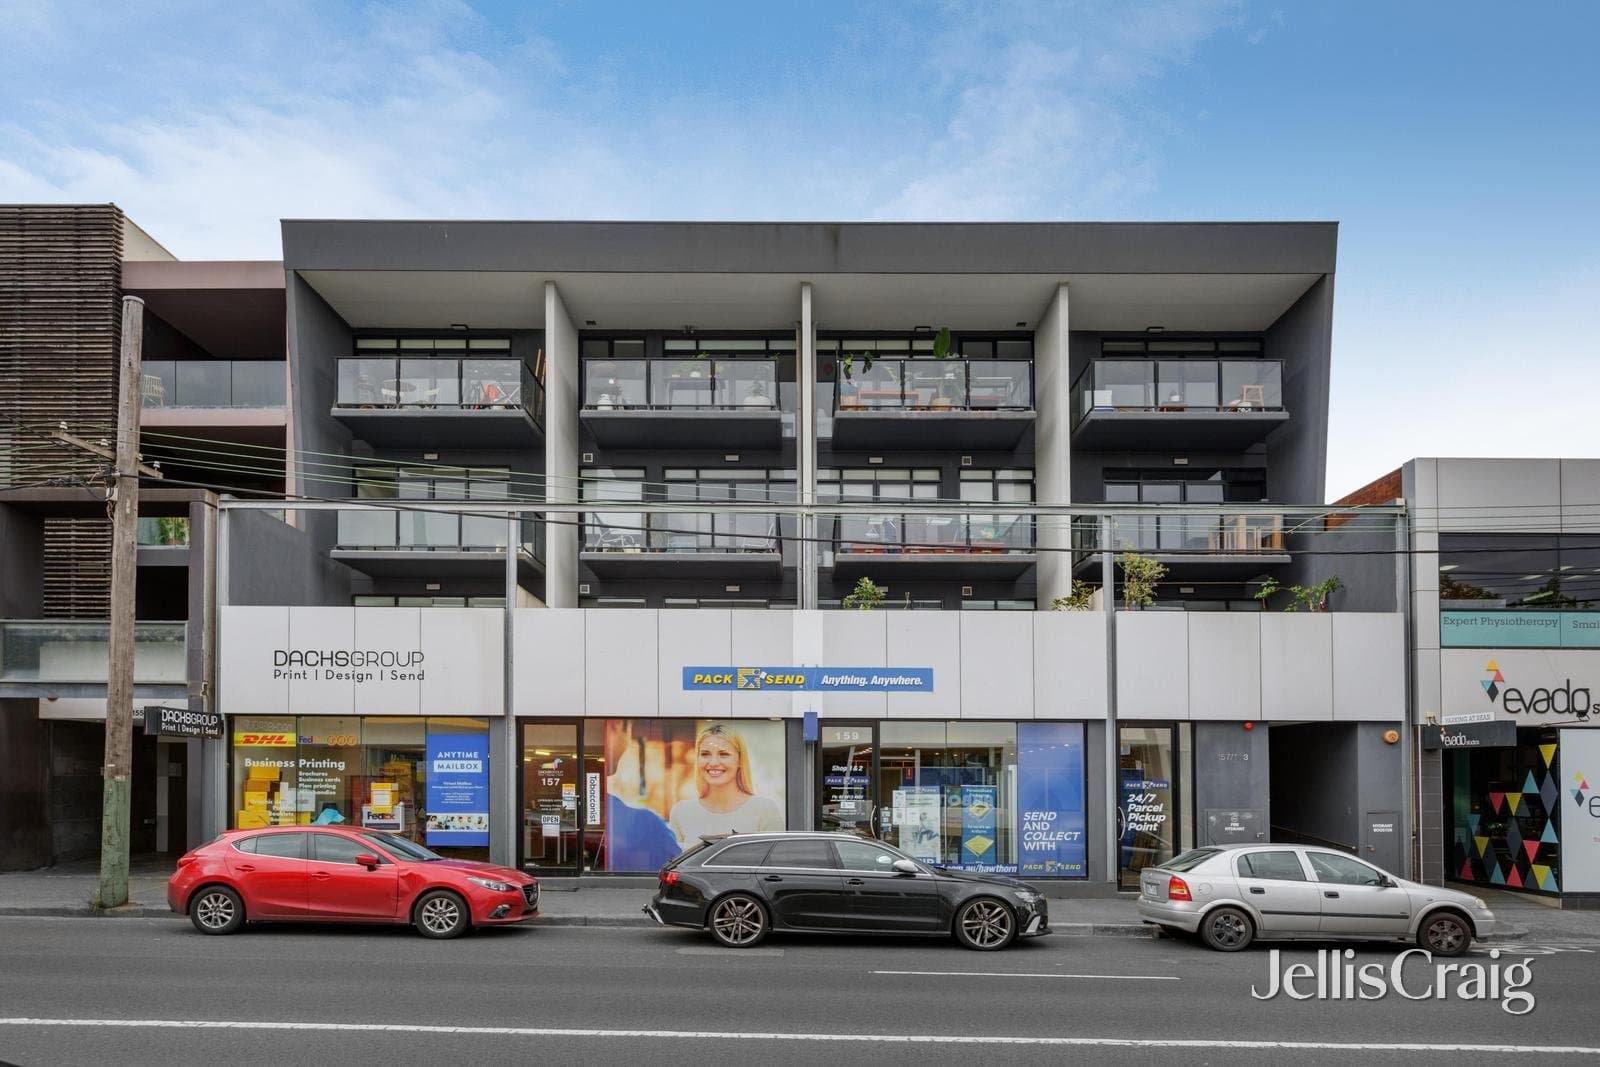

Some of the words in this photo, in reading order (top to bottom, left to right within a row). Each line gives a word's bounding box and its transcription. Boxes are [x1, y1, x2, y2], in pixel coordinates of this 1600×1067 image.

[1443, 616, 1478, 626] Expert
[1480, 616, 1558, 628] Physiotherapy
[274, 650, 425, 667] DACHSGROUP
[274, 669, 307, 680] Print
[325, 669, 373, 682] Design
[390, 669, 425, 681] Send
[693, 674, 734, 684] PACK
[766, 675, 805, 685] SEND
[820, 674, 868, 686] Anything.
[870, 675, 923, 686] Anywhere.
[162, 710, 218, 726] DACHSGROUP
[162, 723, 176, 732] Print
[182, 724, 200, 734] Design
[206, 727, 218, 735] Send
[242, 734, 288, 744] DHL
[835, 732, 859, 740] 159
[1444, 732, 1466, 746] evado
[244, 758, 295, 768] Business
[298, 758, 346, 770] Printing
[542, 778, 560, 786] 157
[1127, 793, 1157, 803] 24/7
[1128, 803, 1163, 812] Parcel
[1024, 812, 1056, 820] SEND
[1128, 812, 1166, 822] Pickup
[1023, 822, 1050, 830] AND
[1128, 822, 1159, 832] Point
[1024, 832, 1081, 840] COLLECT
[1023, 842, 1056, 850] WITH
